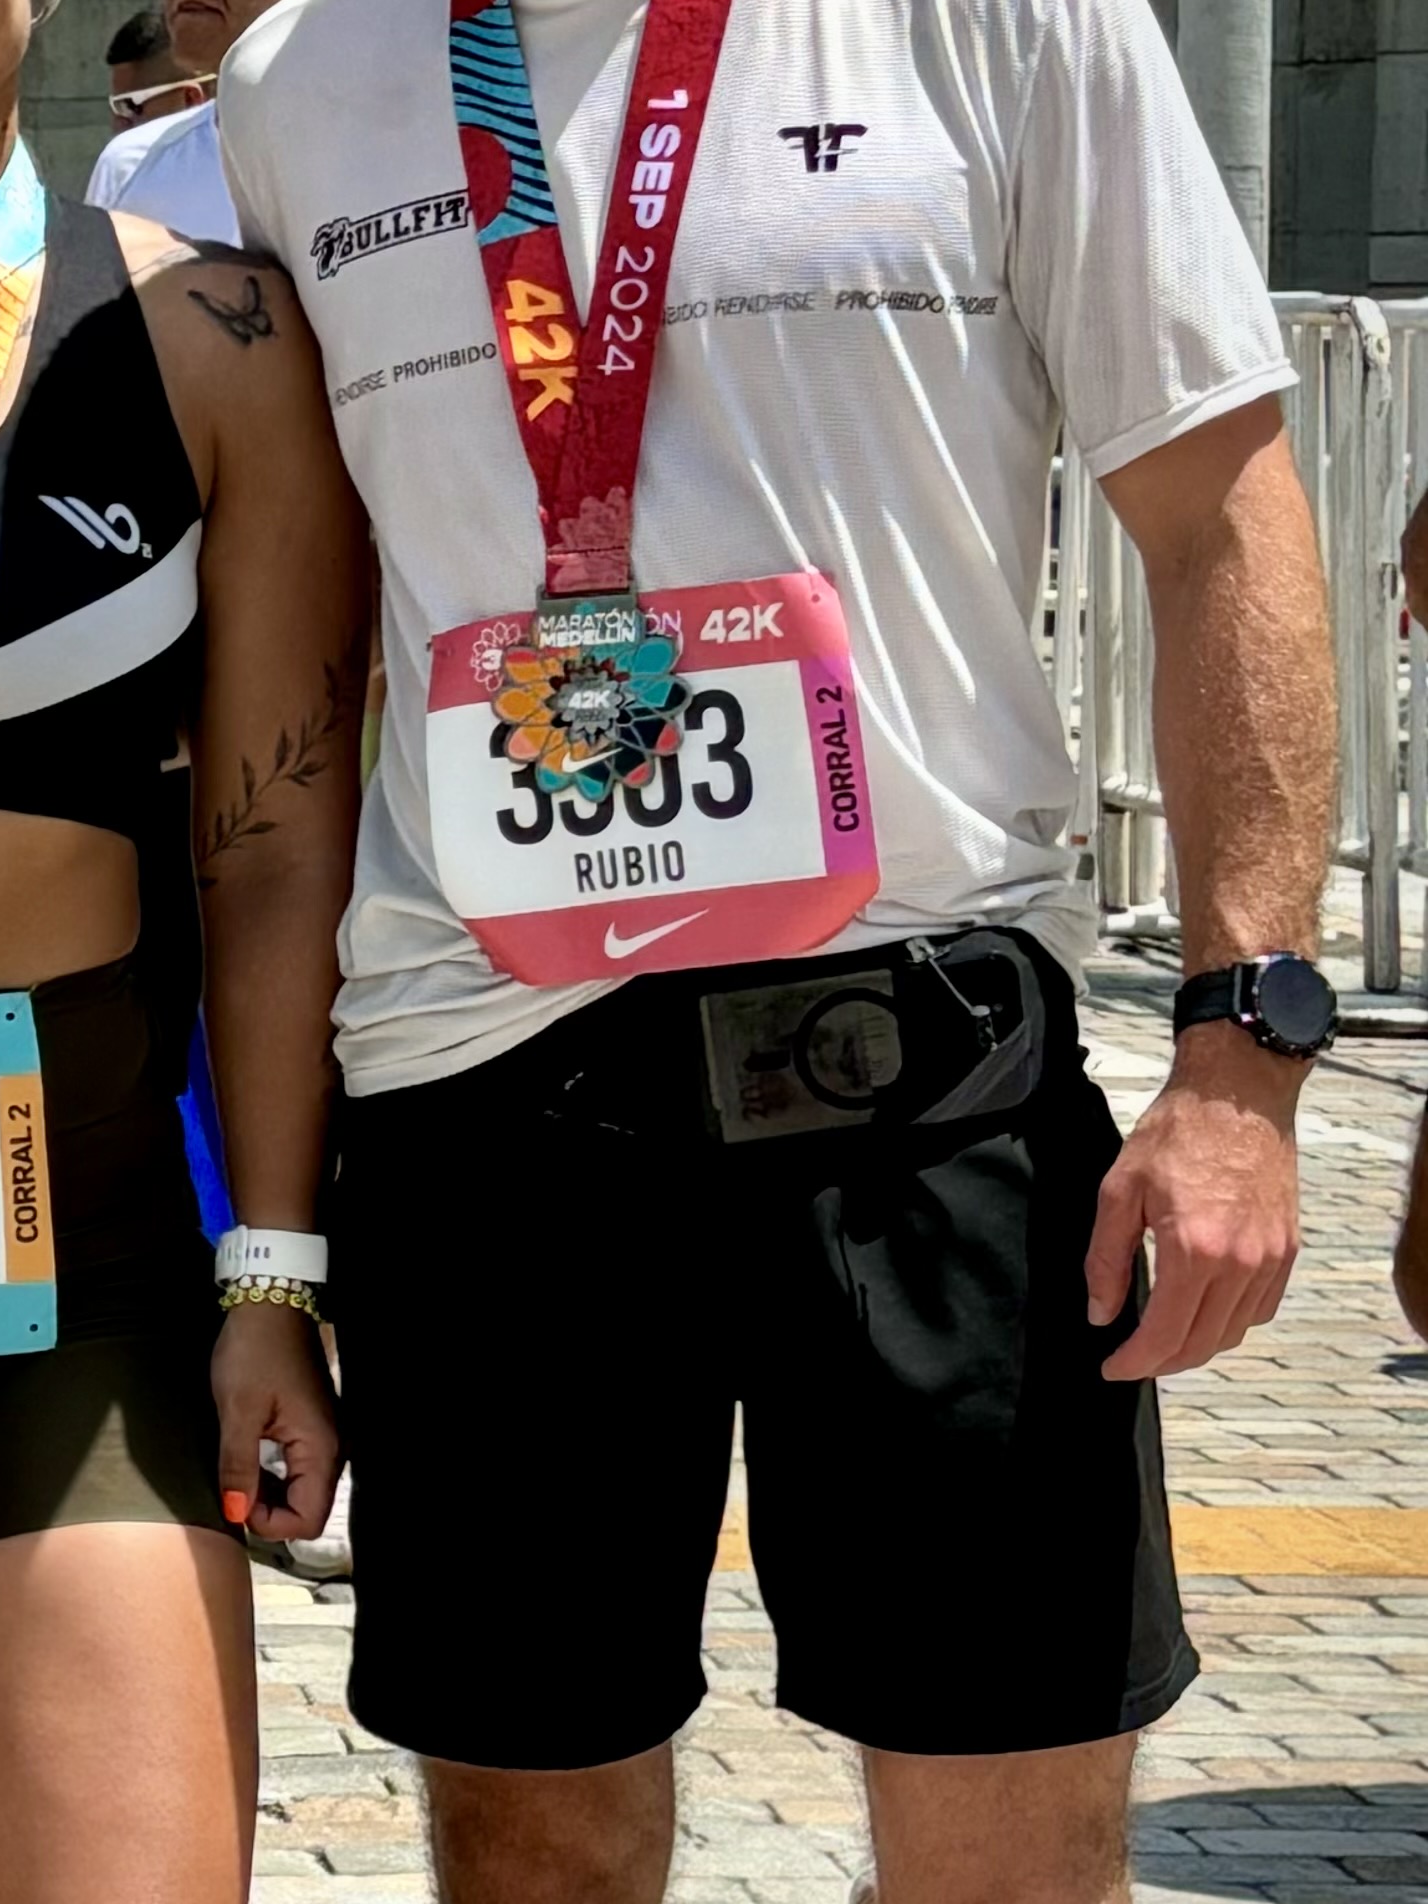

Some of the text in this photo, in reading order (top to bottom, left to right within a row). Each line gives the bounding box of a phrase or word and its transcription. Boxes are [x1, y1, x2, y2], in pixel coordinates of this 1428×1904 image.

[597, 90, 689, 376] 1 SEP 2024
[392, 342, 497, 383] PROHIBIDO
[504, 280, 579, 422] 42K
[700, 602, 784, 644] 42K
[567, 690, 612, 709] 42K
[816, 685, 862, 834] CORRAL 2
[574, 840, 686, 893] RUBIO
[7, 1102, 40, 1244] CORRAL 2
